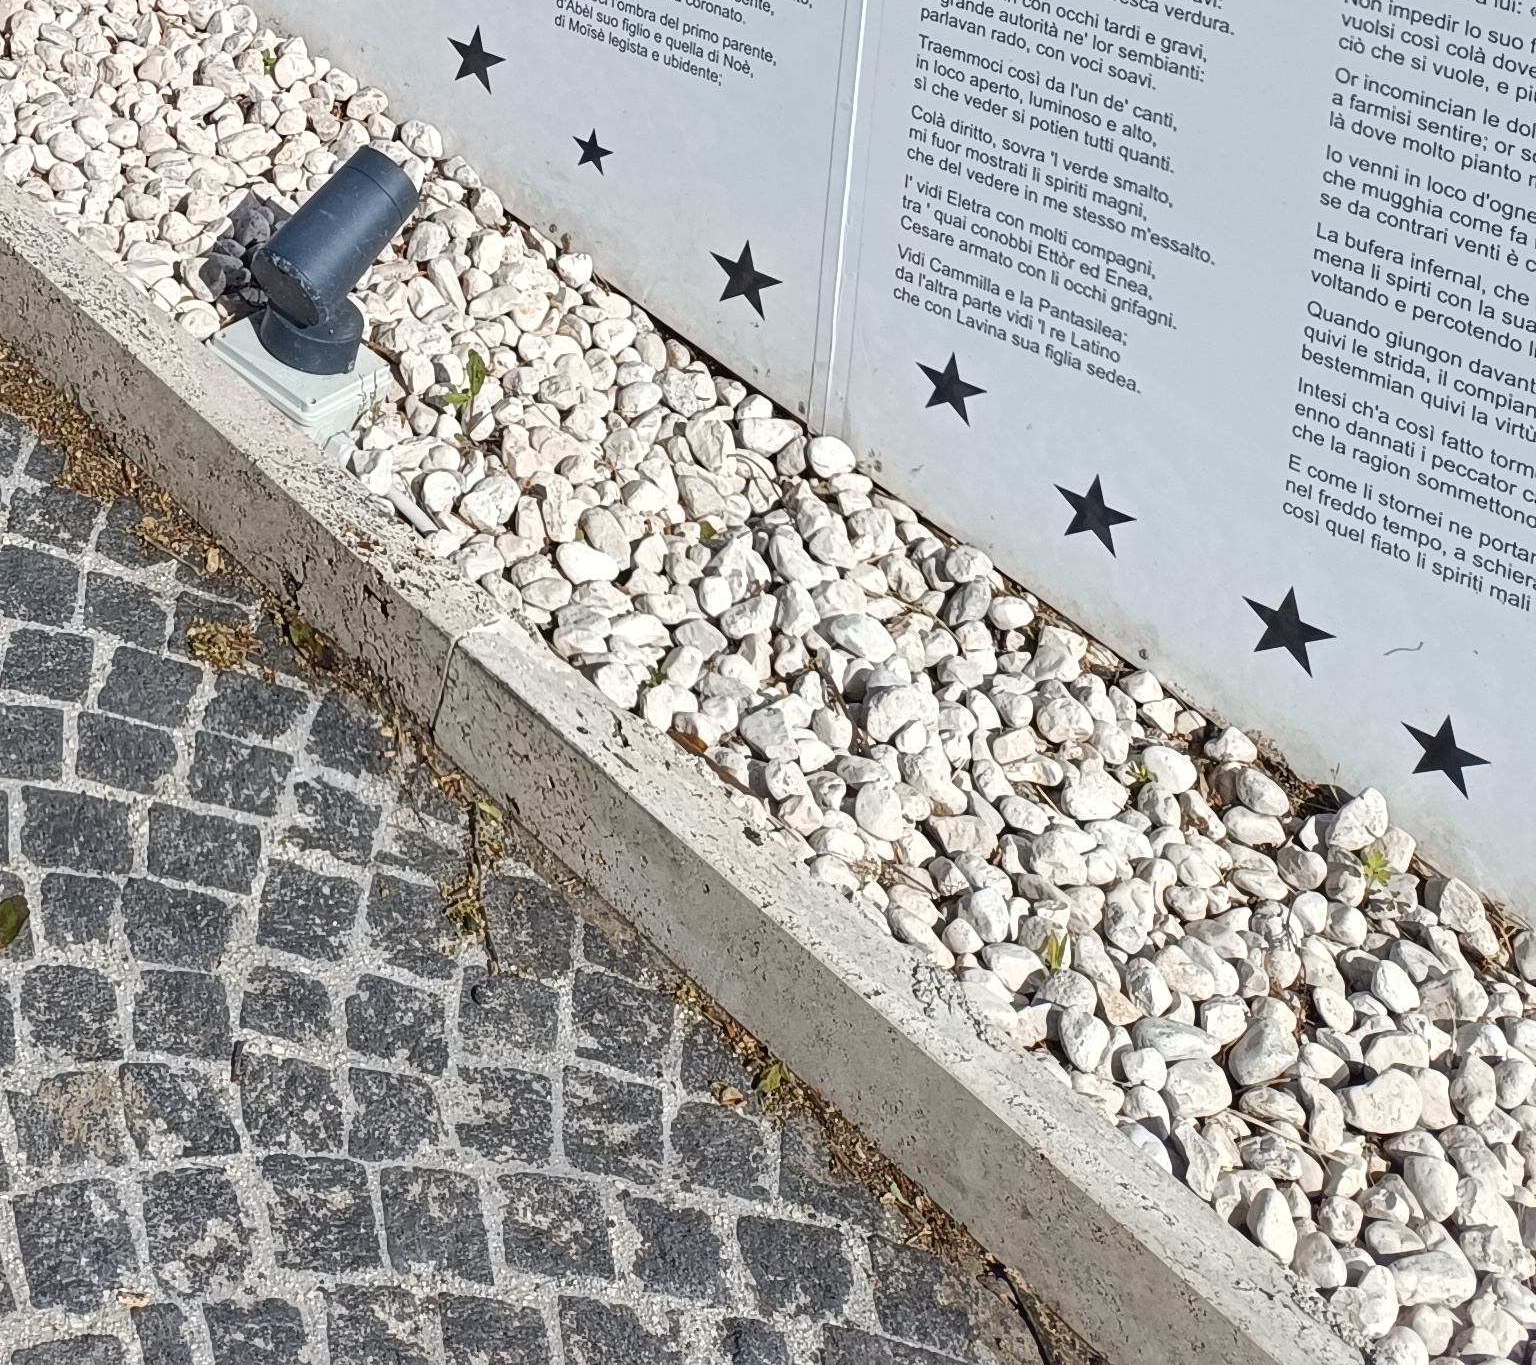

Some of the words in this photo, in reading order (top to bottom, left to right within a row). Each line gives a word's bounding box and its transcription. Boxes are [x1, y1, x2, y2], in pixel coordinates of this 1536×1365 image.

[659, 13, 680, 31] del
[682, 23, 719, 44] primo
[1056, 6, 1100, 29] occhi
[1104, 17, 1141, 42] tardi
[1145, 33, 1156, 45] e
[1316, 222, 1339, 244] La
[1345, 231, 1404, 266] bufera
[1494, 284, 1530, 307] che
[893, 287, 921, 307] che
[924, 300, 952, 320] con
[956, 308, 1007, 342] Lavina
[1011, 334, 1040, 355] sua
[1045, 343, 1082, 371] figlia
